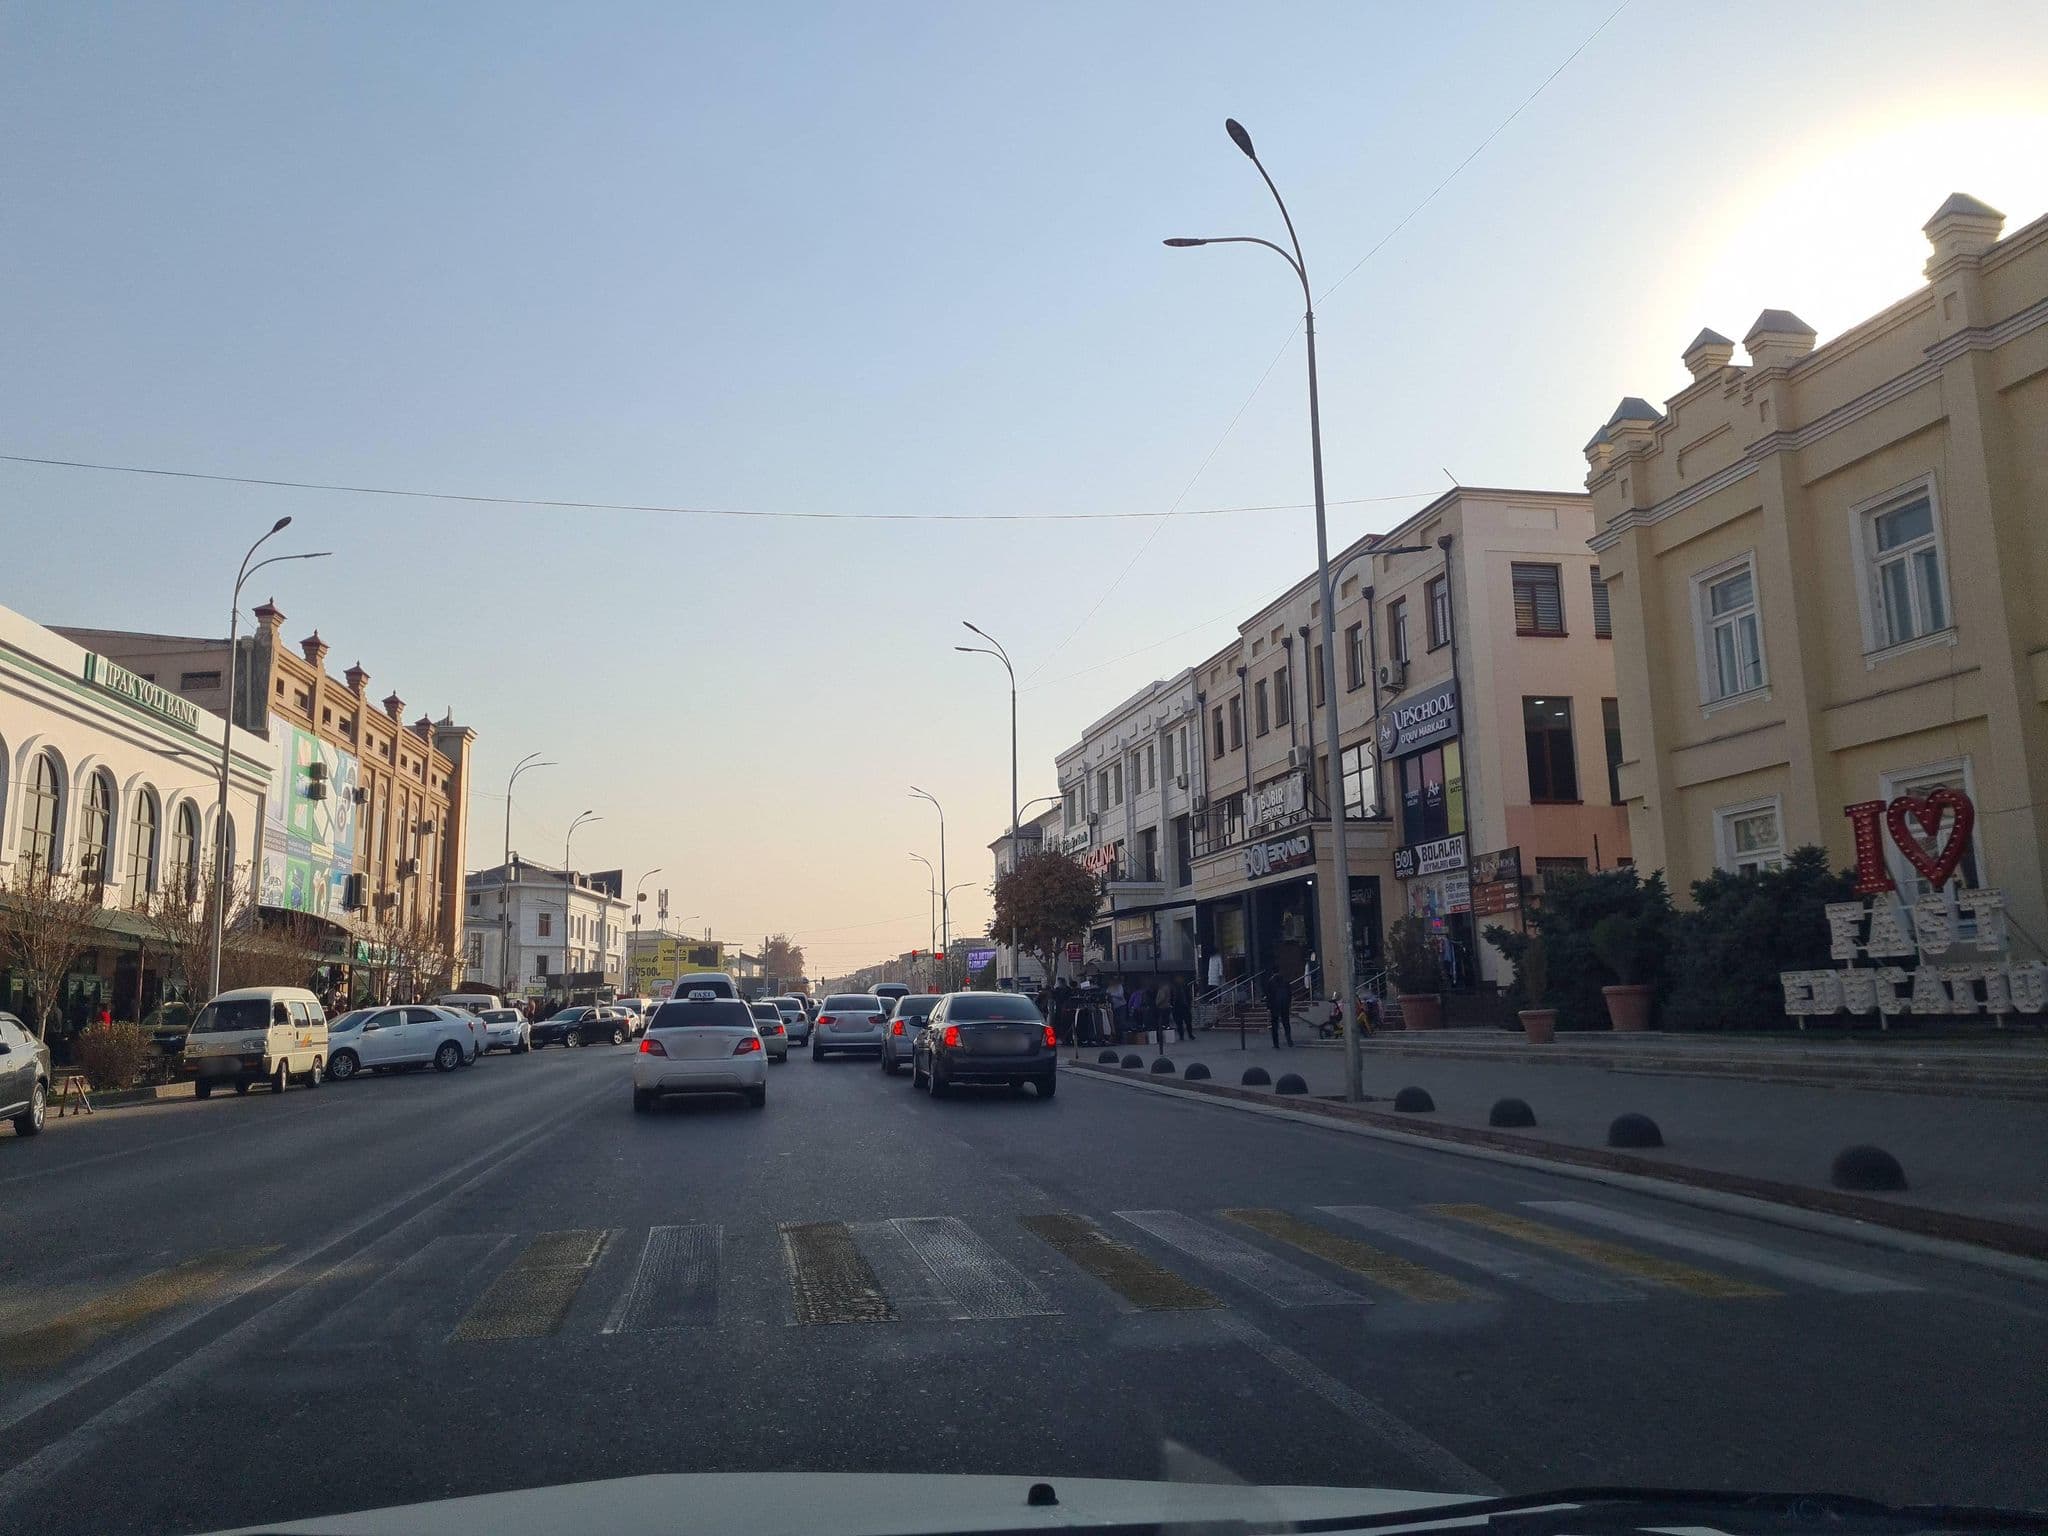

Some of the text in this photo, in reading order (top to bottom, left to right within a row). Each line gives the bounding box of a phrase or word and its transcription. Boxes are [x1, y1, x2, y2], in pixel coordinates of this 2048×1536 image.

[107, 664, 136, 699] IPAK
[167, 694, 200, 726] BANKI
[1418, 719, 1446, 737] MARKAZI
[1825, 888, 2004, 960] FAST
